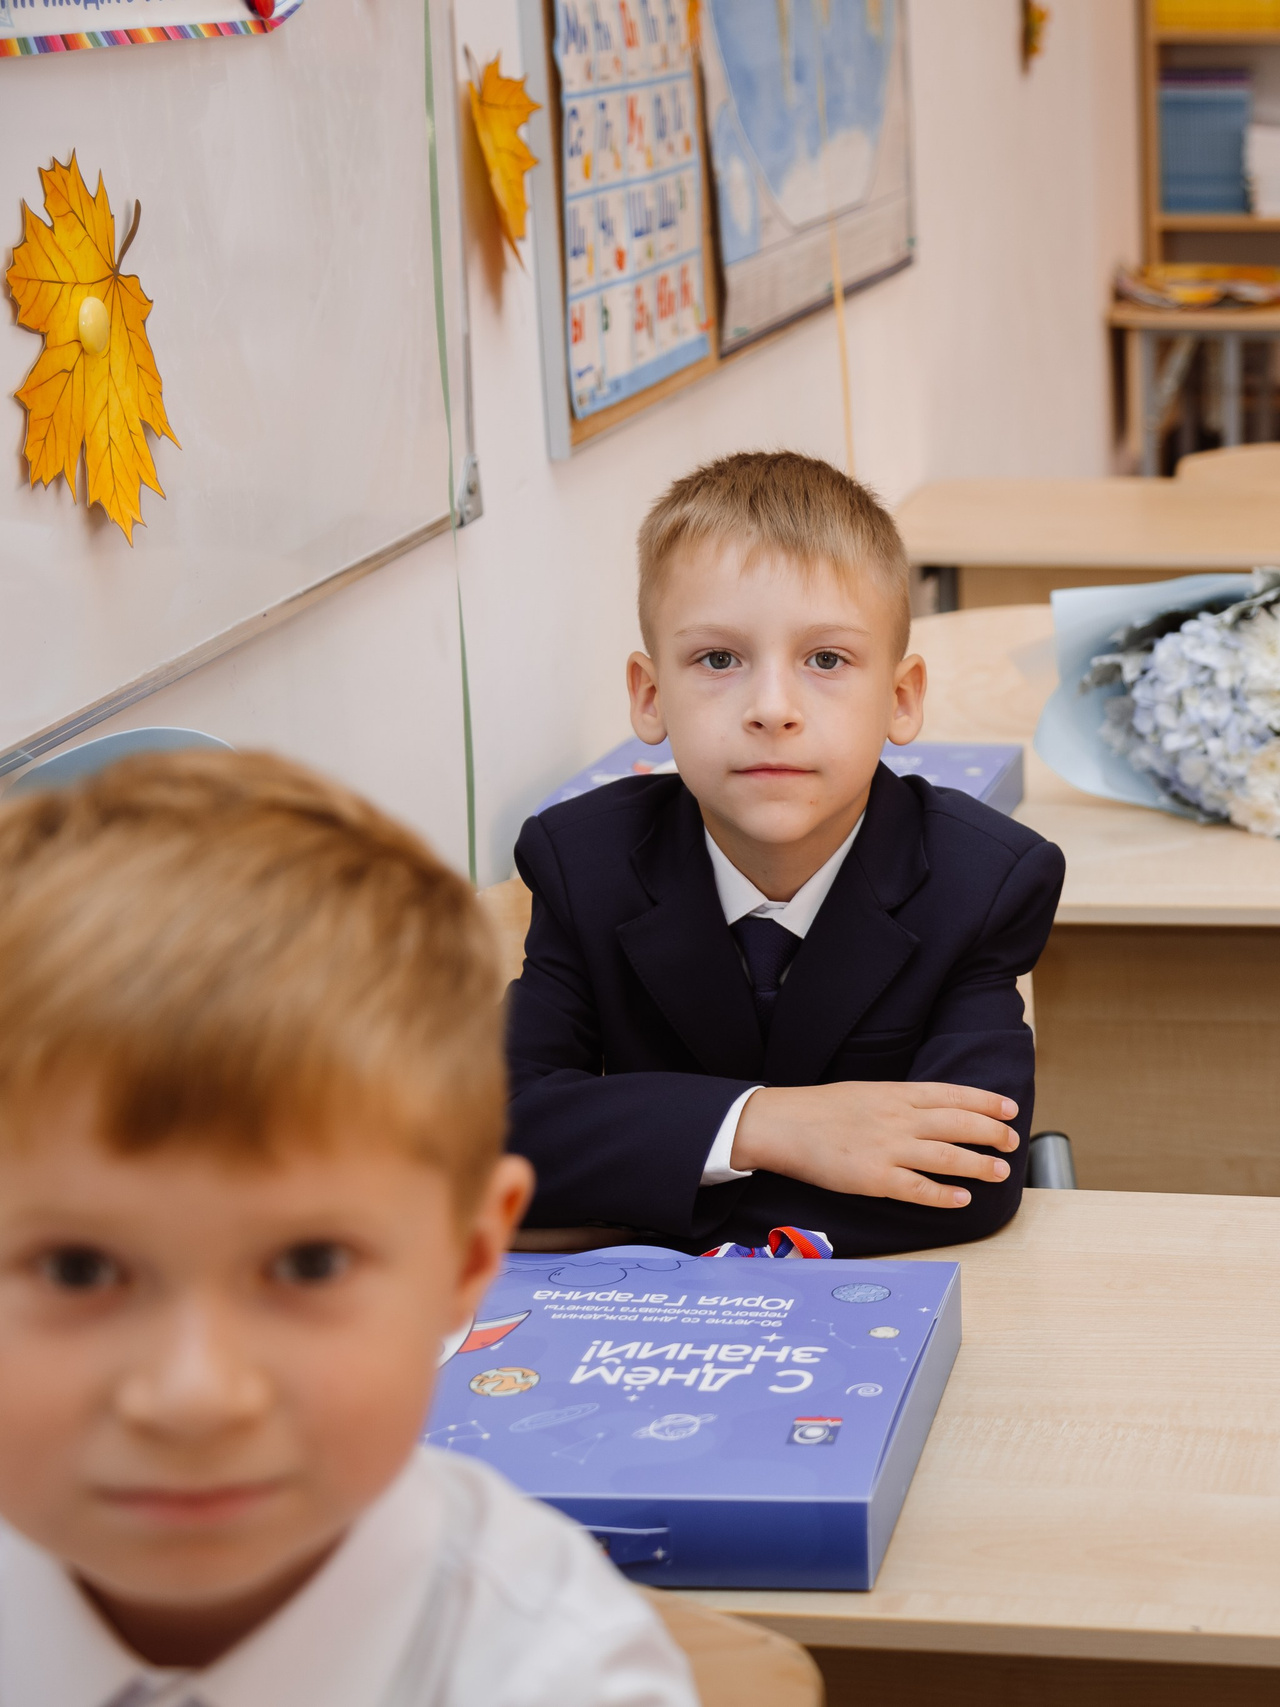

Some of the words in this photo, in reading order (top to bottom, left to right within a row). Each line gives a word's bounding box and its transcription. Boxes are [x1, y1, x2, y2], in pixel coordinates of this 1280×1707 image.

[532, 1290, 688, 1307] Гагарина
[696, 1295, 795, 1312] Юрия
[543, 1303, 616, 1312] планеты
[619, 1306, 718, 1316] космонавта
[550, 1312, 640, 1322] рождения
[642, 1315, 678, 1324] дня
[721, 1310, 788, 1319] первого
[680, 1316, 701, 1324] со
[704, 1317, 783, 1328] 90-летие
[580, 1340, 829, 1366] знаний!
[569, 1362, 756, 1392] Днём
[768, 1369, 814, 1394] С
